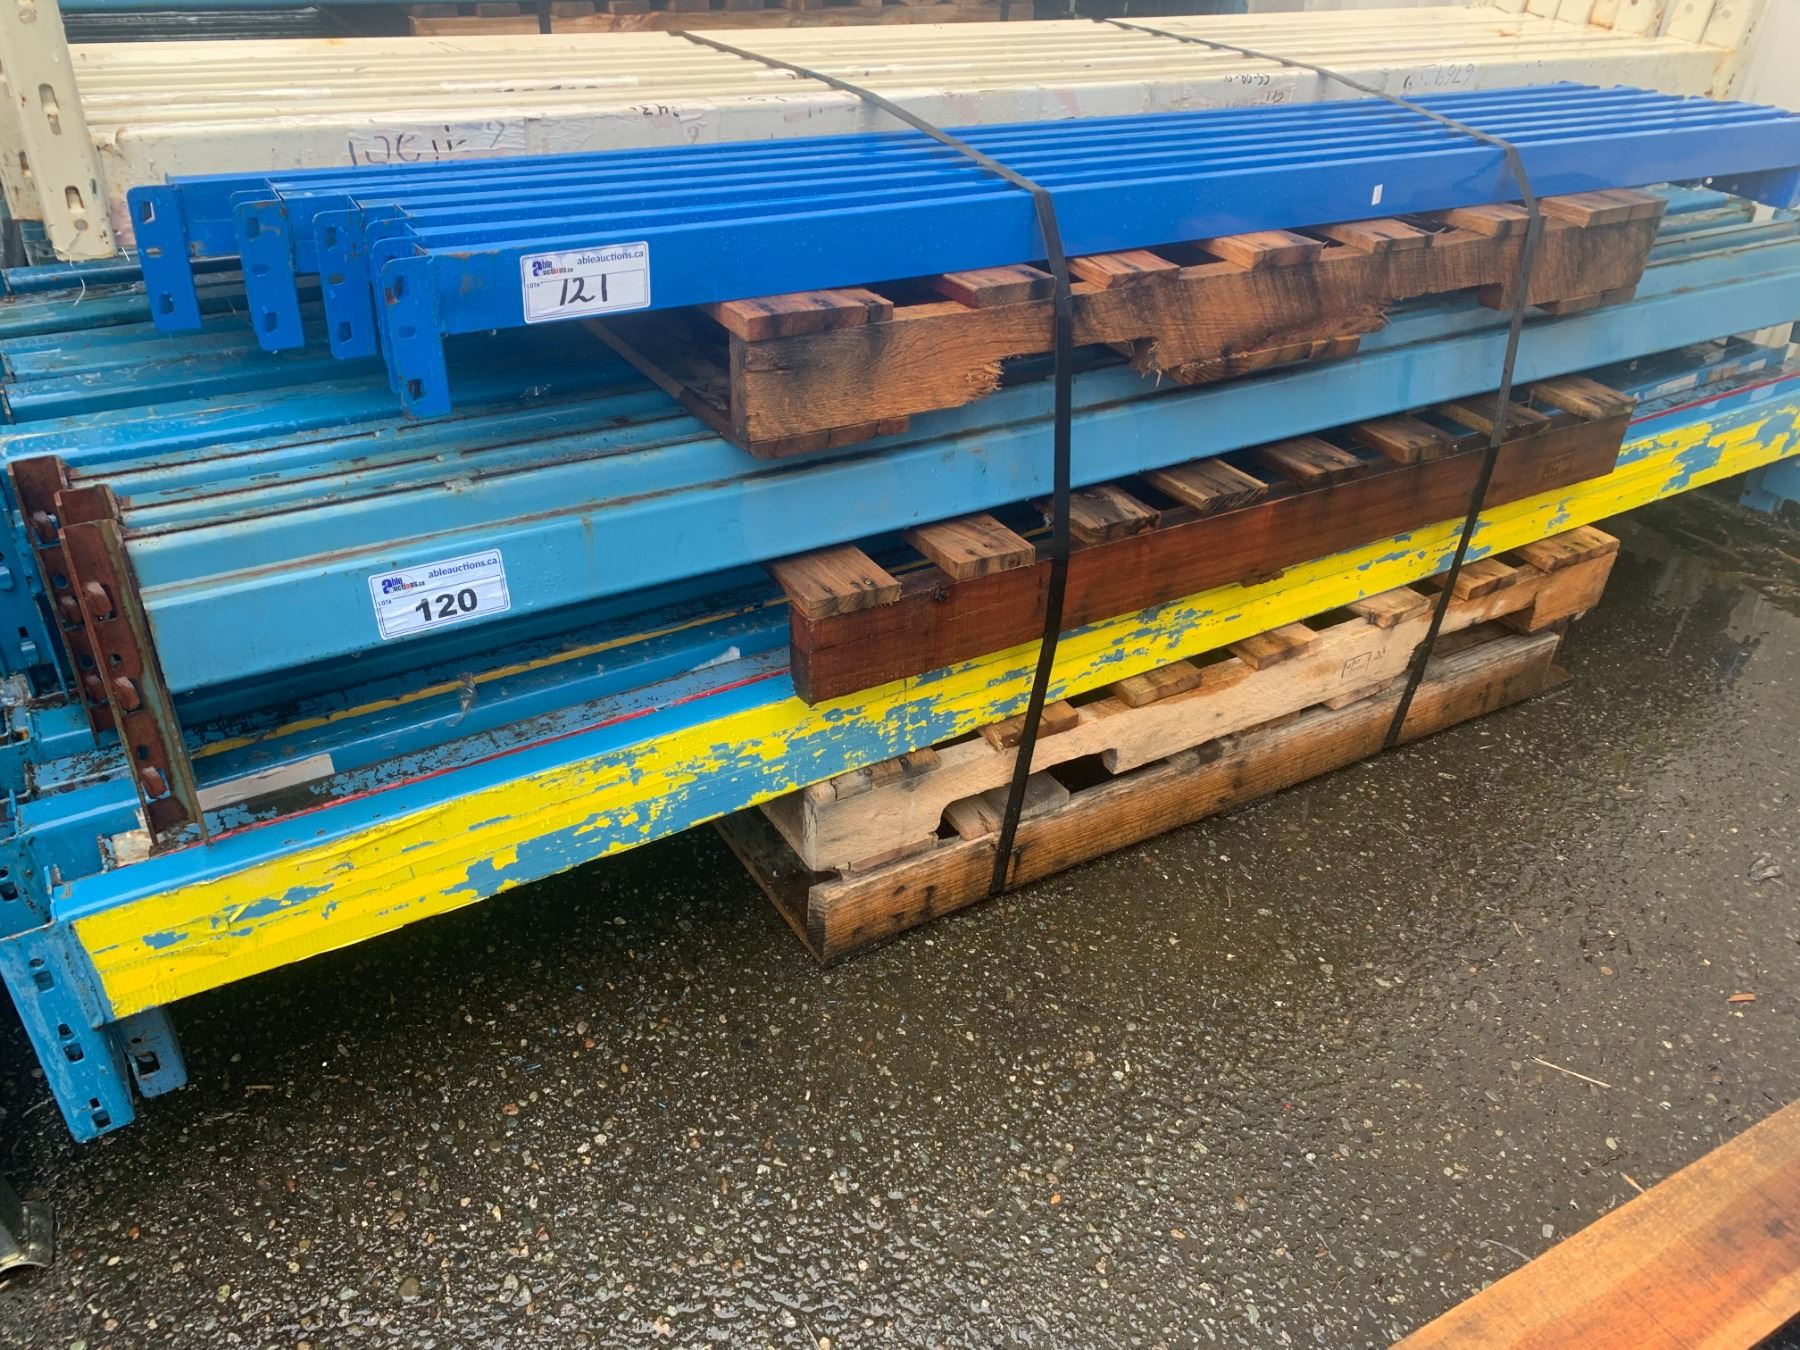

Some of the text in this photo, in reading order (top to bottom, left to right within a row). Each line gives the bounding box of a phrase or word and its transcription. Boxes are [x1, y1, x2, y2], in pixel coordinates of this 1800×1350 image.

[577, 251, 644, 265] ableauctions.ca
[559, 273, 608, 306] 121
[428, 557, 498, 579] ableauctions.ca
[415, 588, 478, 622] 120
